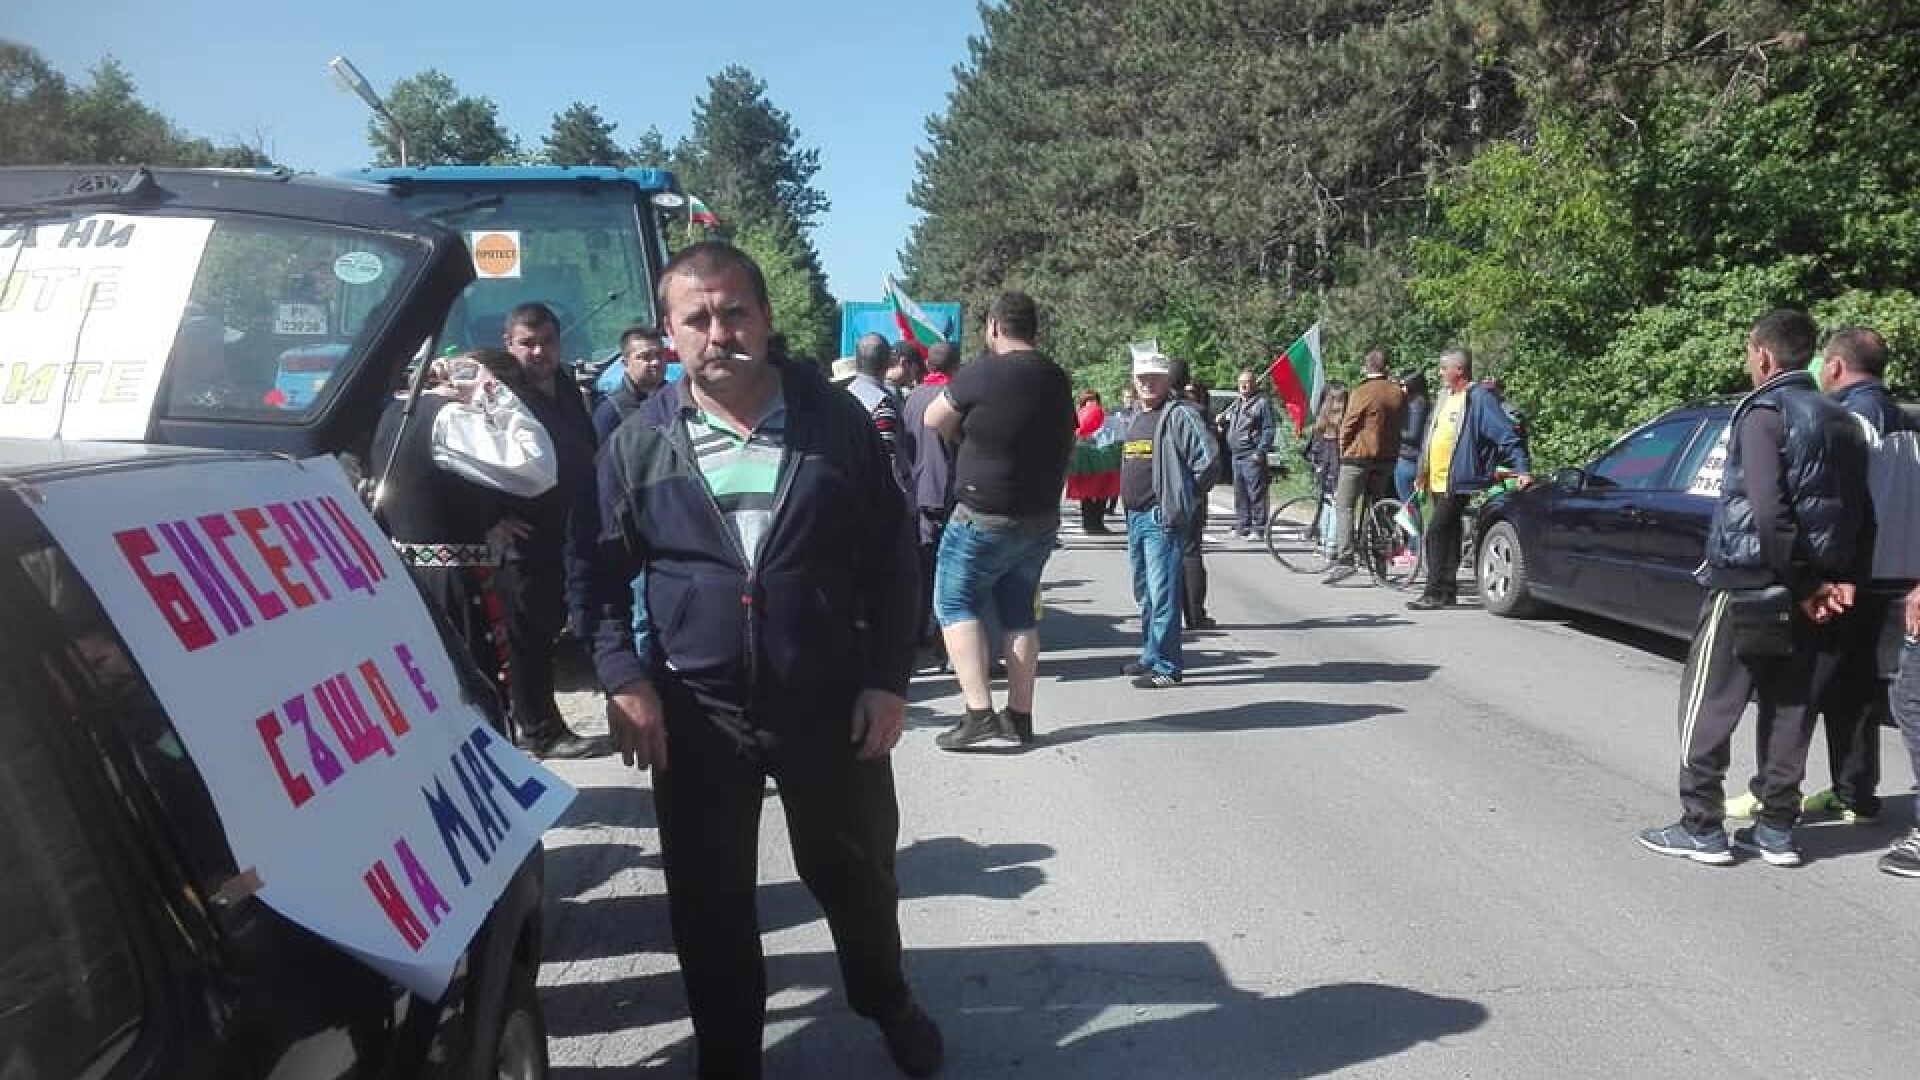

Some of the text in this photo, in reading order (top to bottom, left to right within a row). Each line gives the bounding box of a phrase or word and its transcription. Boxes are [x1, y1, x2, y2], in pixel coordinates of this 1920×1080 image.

[58, 219, 136, 248] НИ
[476, 249, 516, 259] ПРОТЕСТ
[0, 360, 148, 404] ИТЕ
[112, 496, 388, 652] БИСЕРЦИ
[256, 643, 440, 808] СЪЩО Е
[363, 726, 547, 952] НА МАРС
